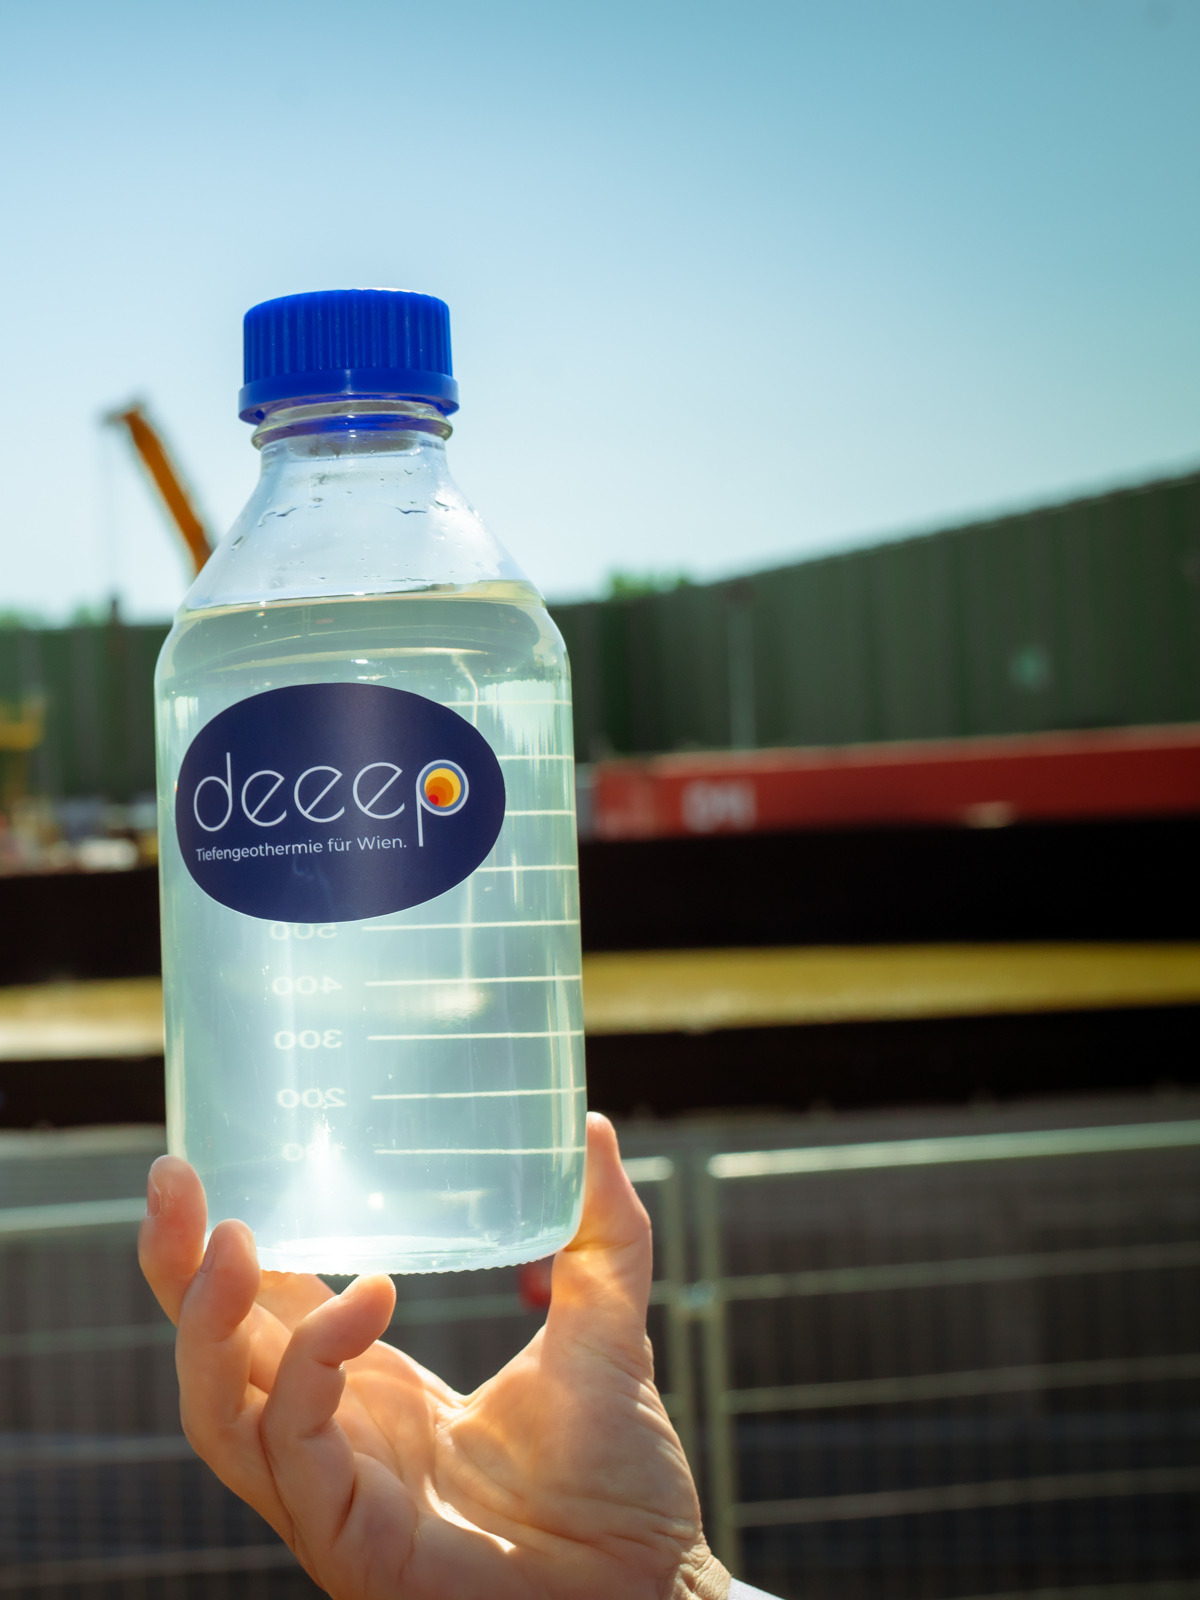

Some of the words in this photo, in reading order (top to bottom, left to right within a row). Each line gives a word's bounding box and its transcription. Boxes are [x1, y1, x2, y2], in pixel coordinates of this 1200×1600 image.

[193, 751, 470, 847] deeep
[196, 838, 323, 863] Tiefengeothermie
[327, 837, 352, 853] für
[356, 835, 407, 851] Wien.
